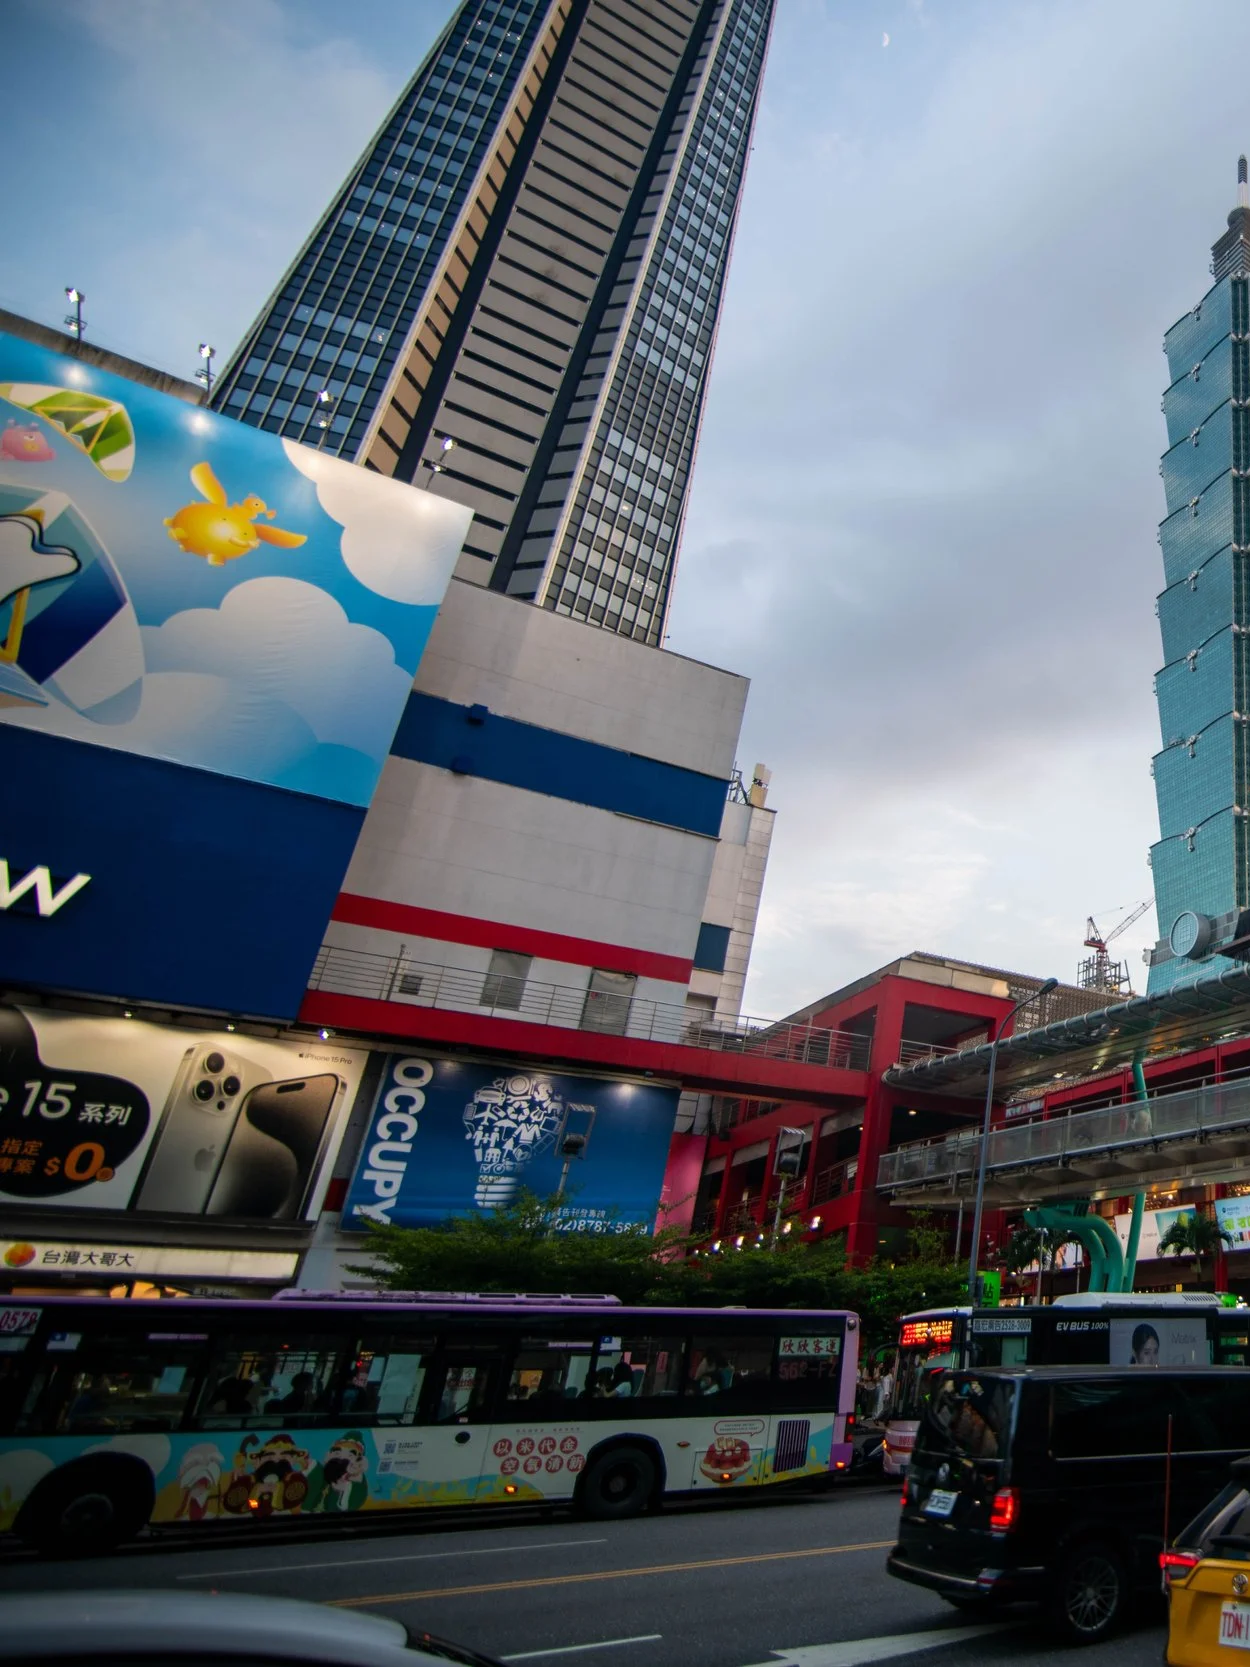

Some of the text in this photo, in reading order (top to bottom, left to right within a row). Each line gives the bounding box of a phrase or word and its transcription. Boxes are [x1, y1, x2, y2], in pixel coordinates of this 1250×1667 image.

[340, 1057, 353, 1065] Pro
[22, 1080, 132, 1126] 15 系列
[2, 1138, 43, 1157] 指定
[352, 1057, 434, 1226] OCCUPY
[42, 1250, 135, 1267] 台灣大哥大
[1056, 1321, 1109, 1331] EV BUS 100%
[783, 1339, 838, 1354] 欣欣客運
